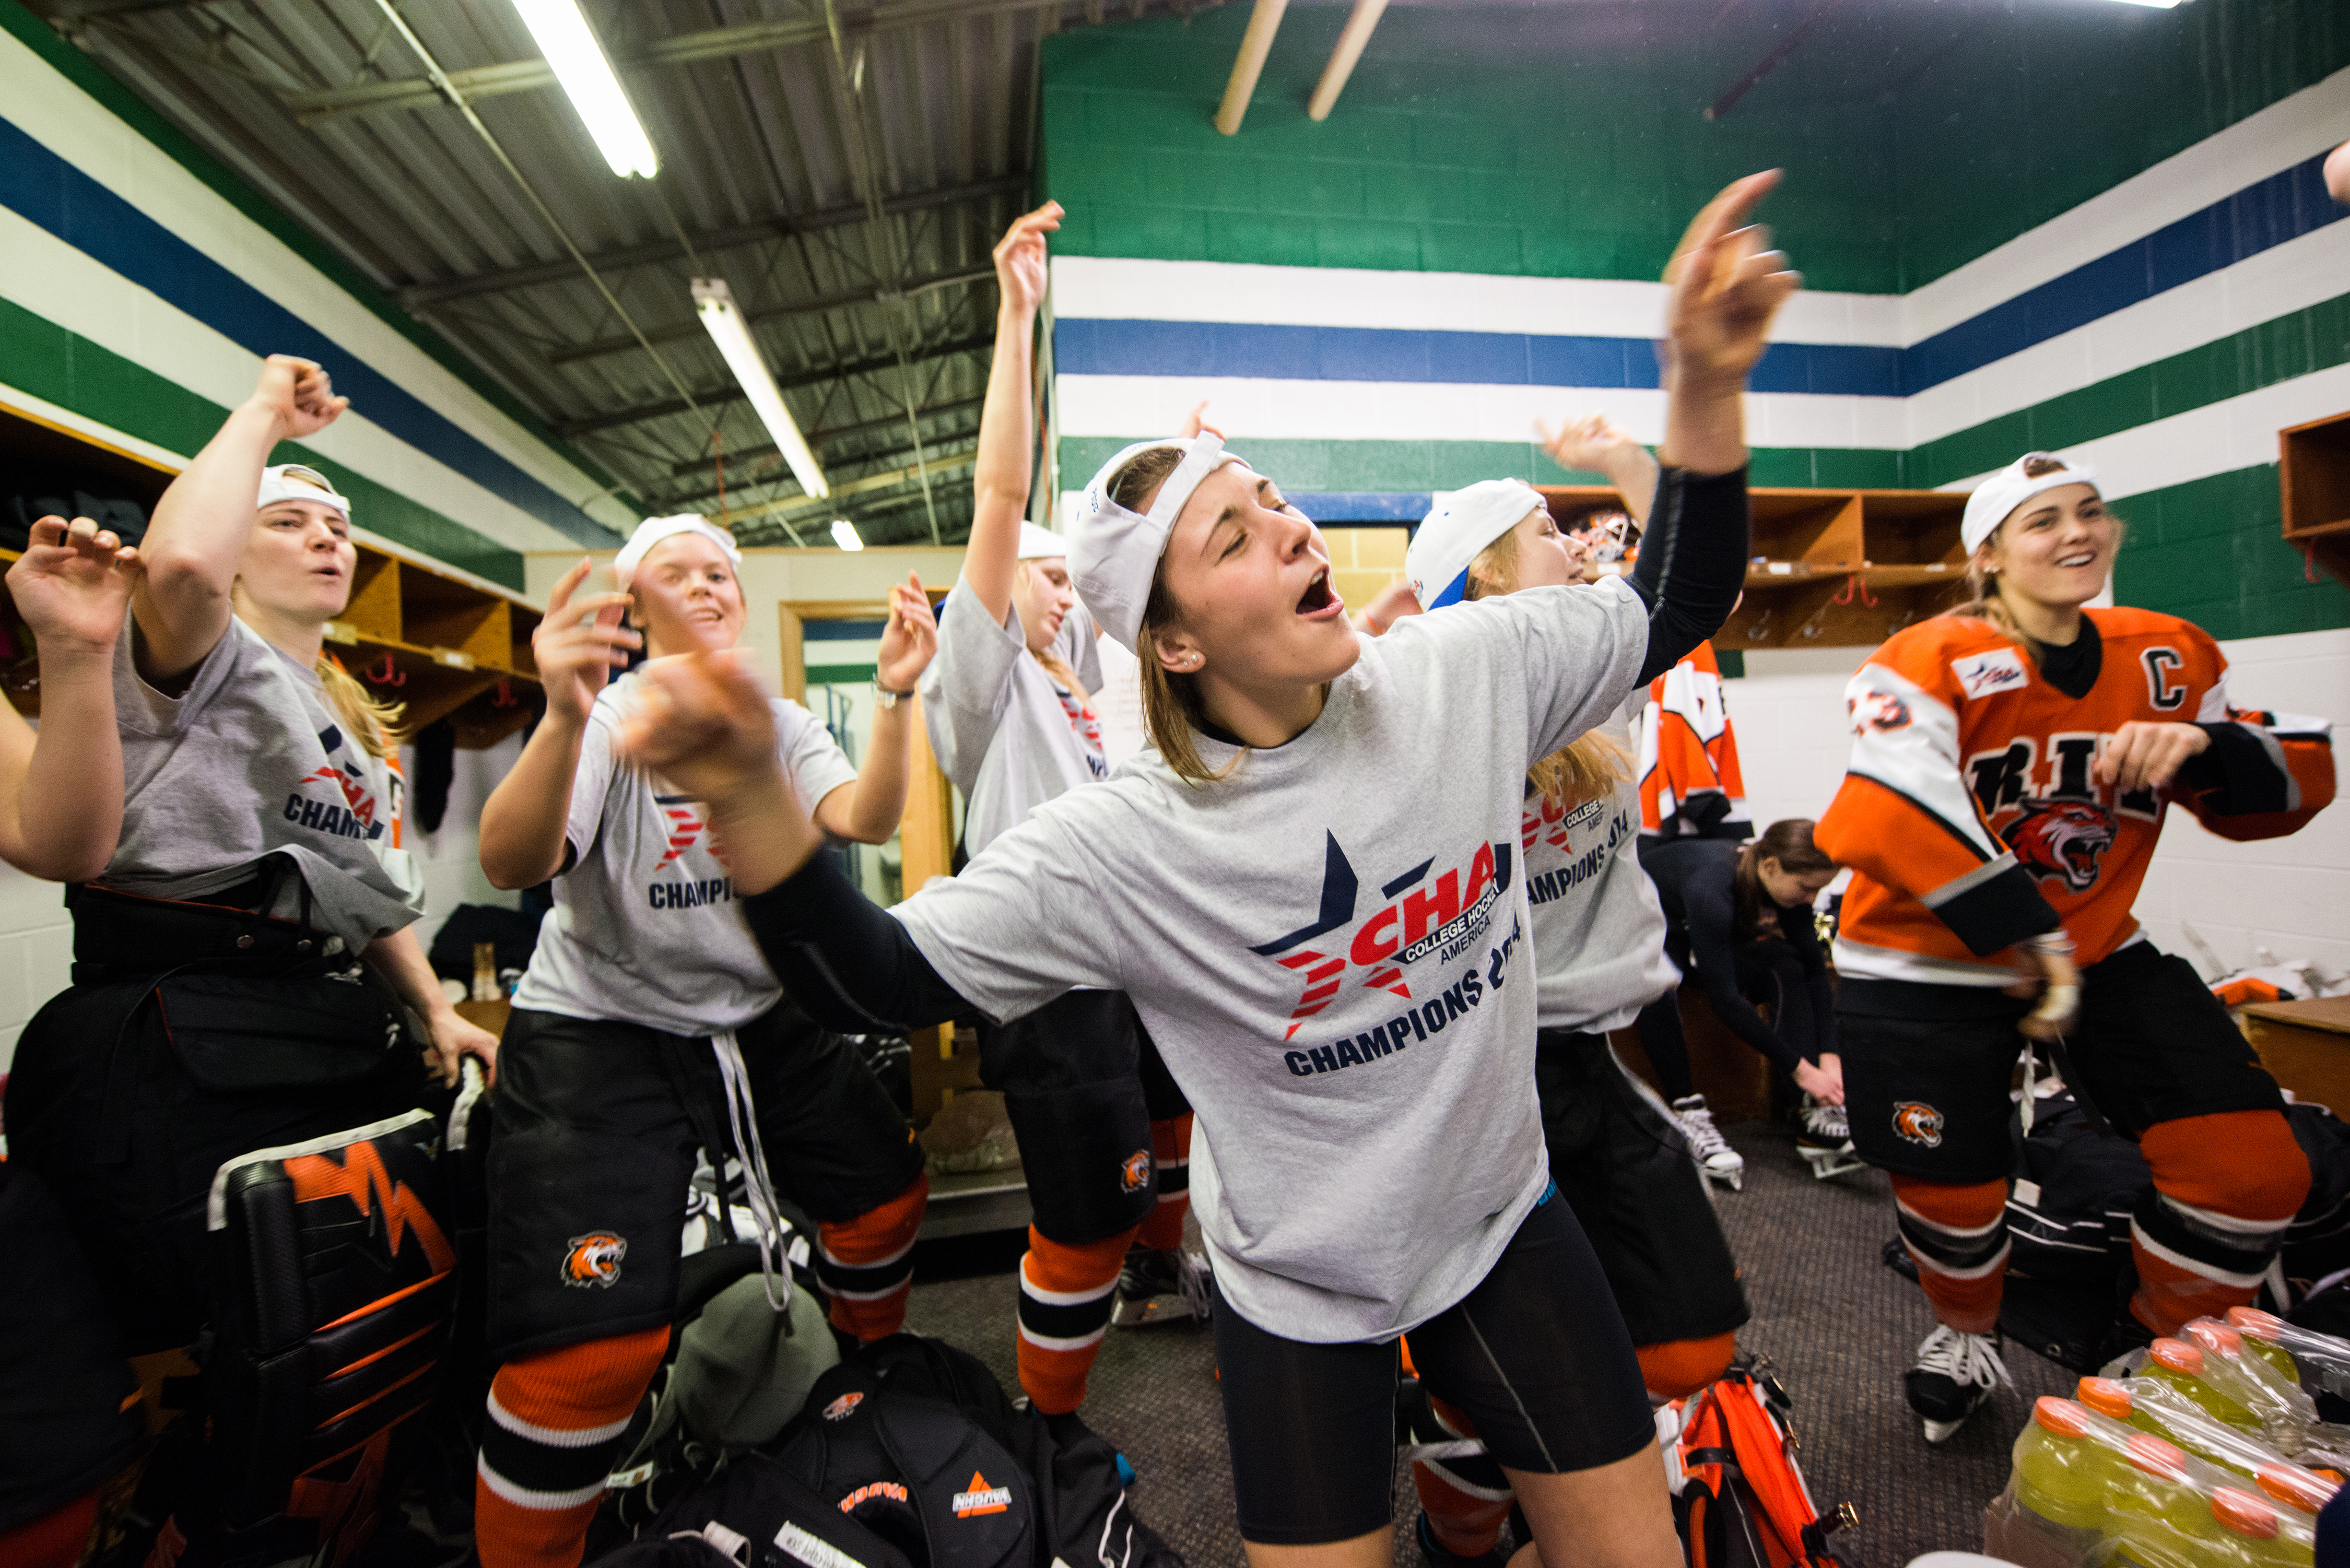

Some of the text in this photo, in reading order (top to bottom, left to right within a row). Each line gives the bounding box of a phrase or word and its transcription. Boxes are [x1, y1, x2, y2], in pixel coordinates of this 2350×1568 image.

[2140, 646, 2187, 711] C
[1566, 799, 1600, 828] COLLEGE
[1349, 840, 1494, 966] CHA
[1405, 923, 1467, 962] COLLEGE
[1440, 914, 1490, 965] AMERICA
[1284, 969, 1484, 1077] CHAMPIONS
[955, 1488, 1009, 1509] VAUGHN
